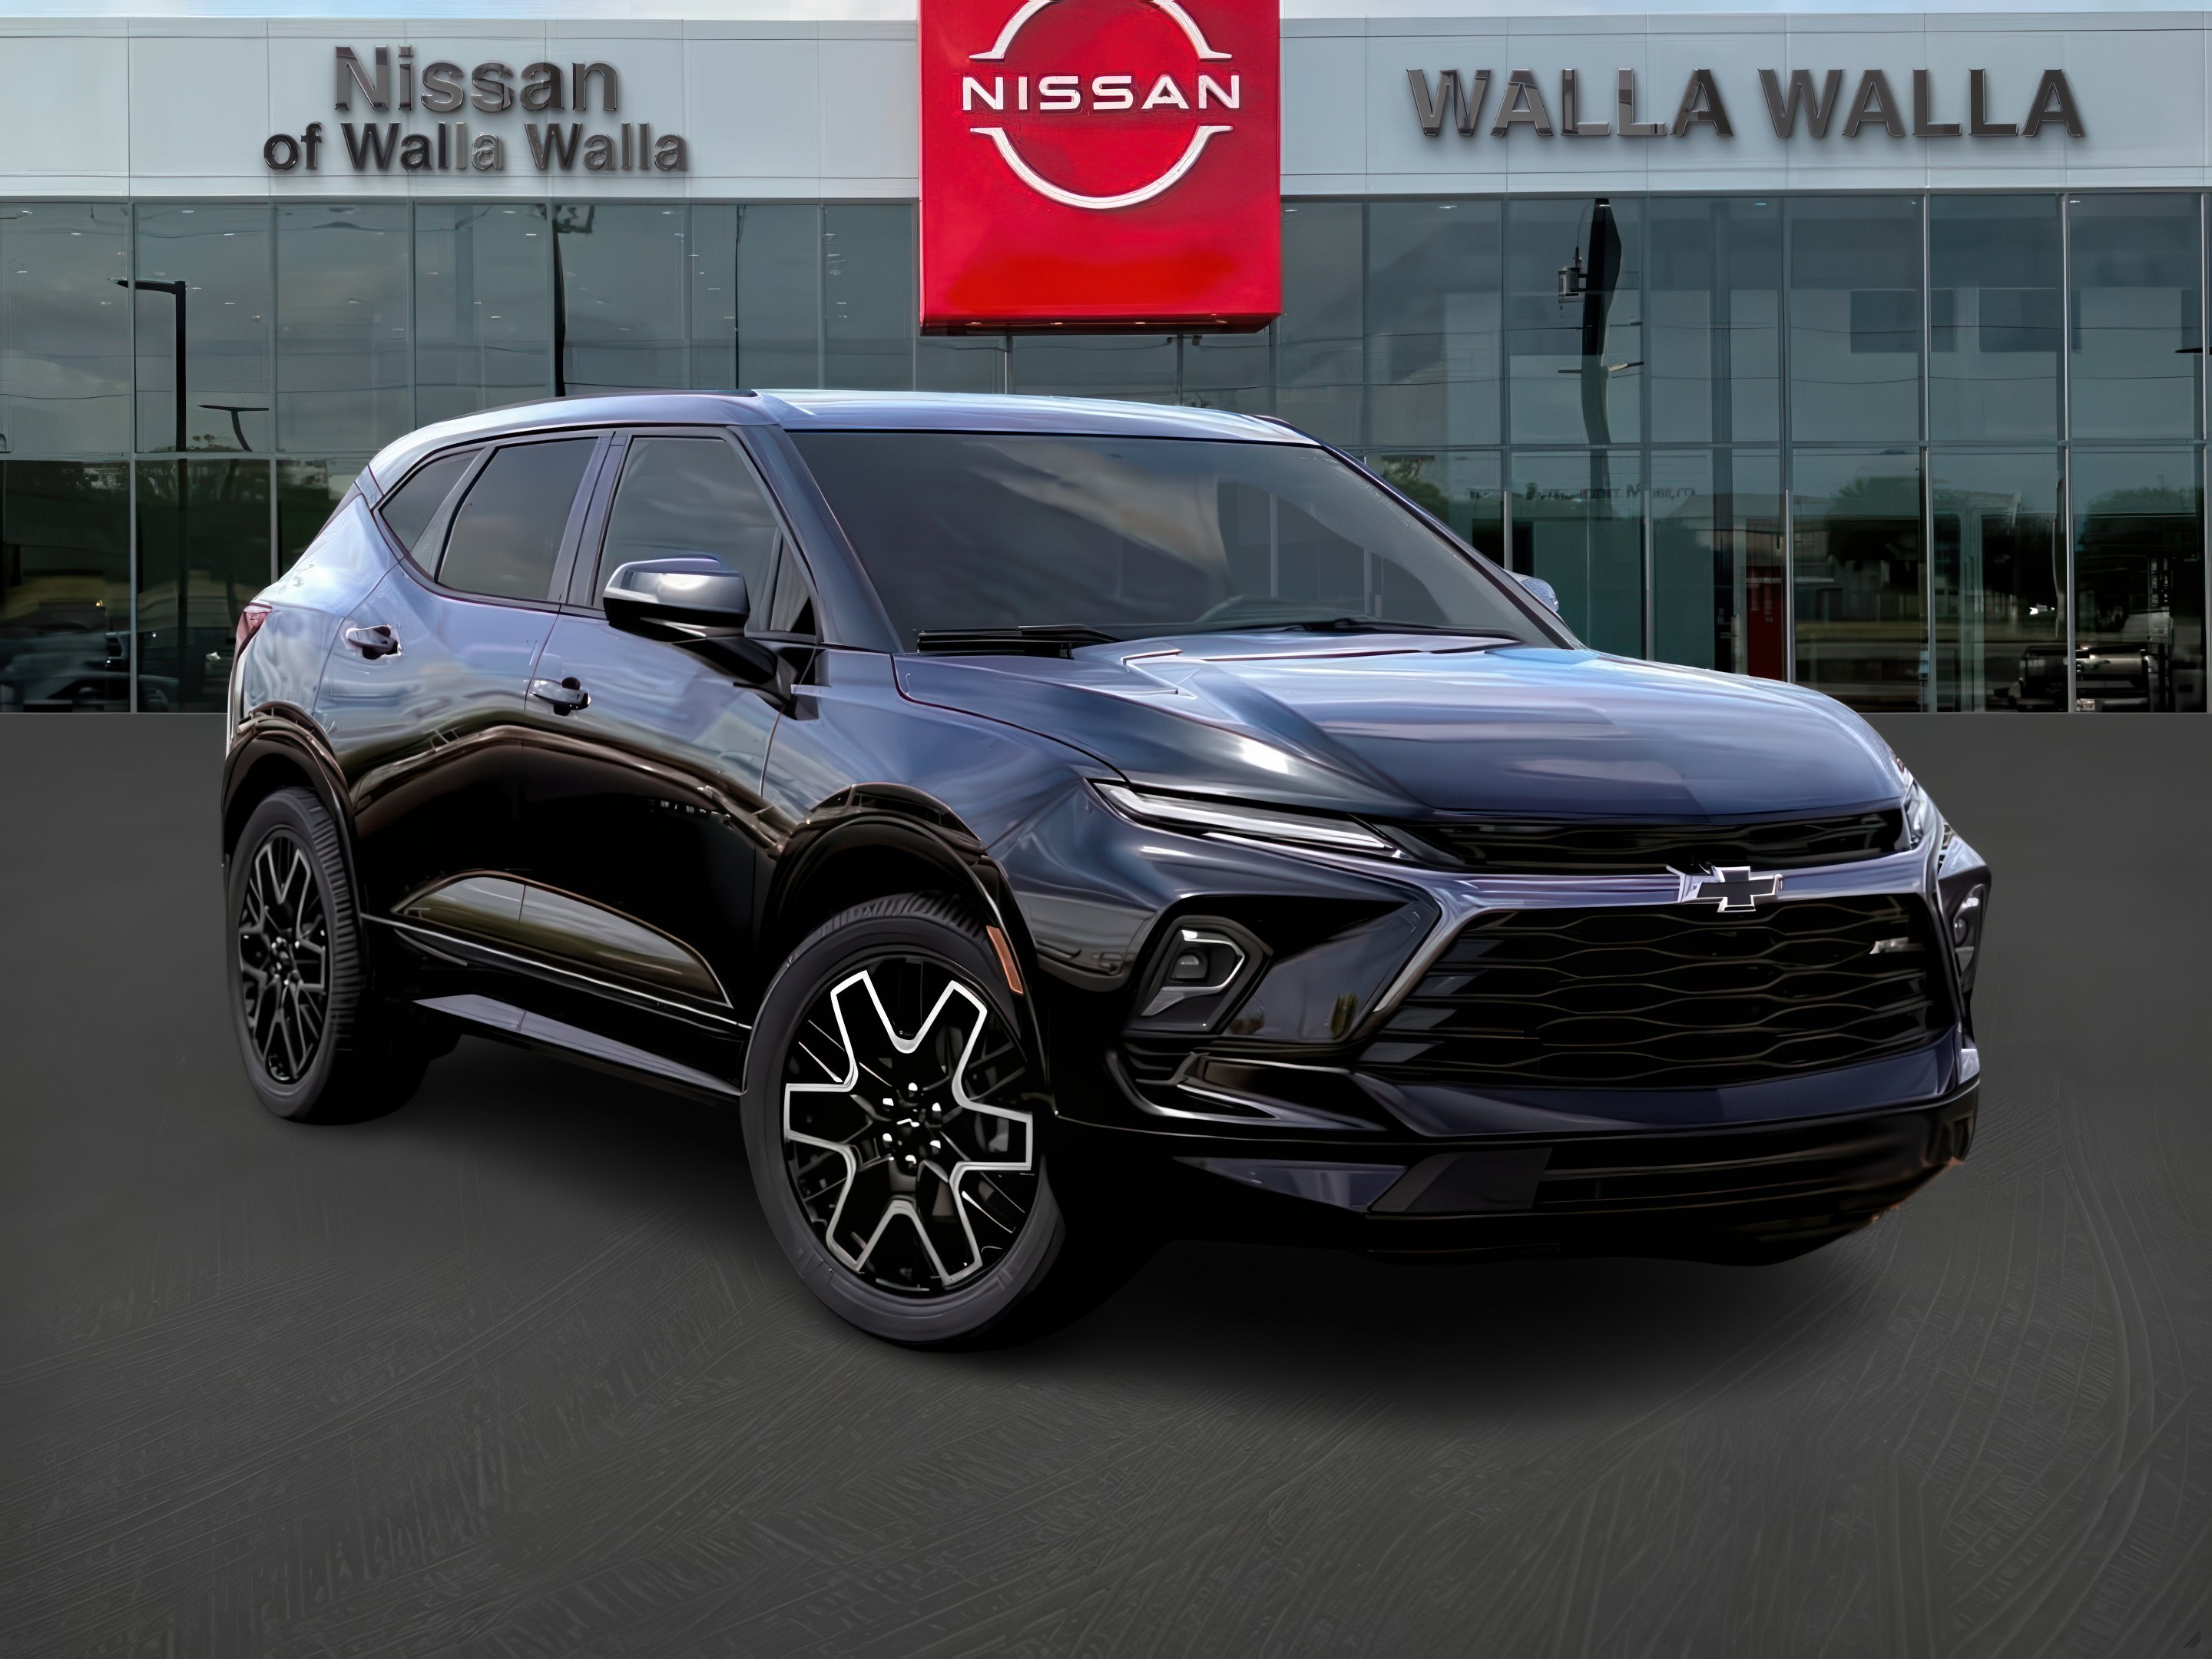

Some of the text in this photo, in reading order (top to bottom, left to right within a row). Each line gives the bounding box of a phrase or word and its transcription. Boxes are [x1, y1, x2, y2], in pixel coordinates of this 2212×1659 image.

[334, 44, 618, 111] Nissan
[962, 75, 1240, 111] NISSAN
[1406, 68, 2085, 137] WALLA WALLA
[263, 121, 688, 171] of Walla Walla
